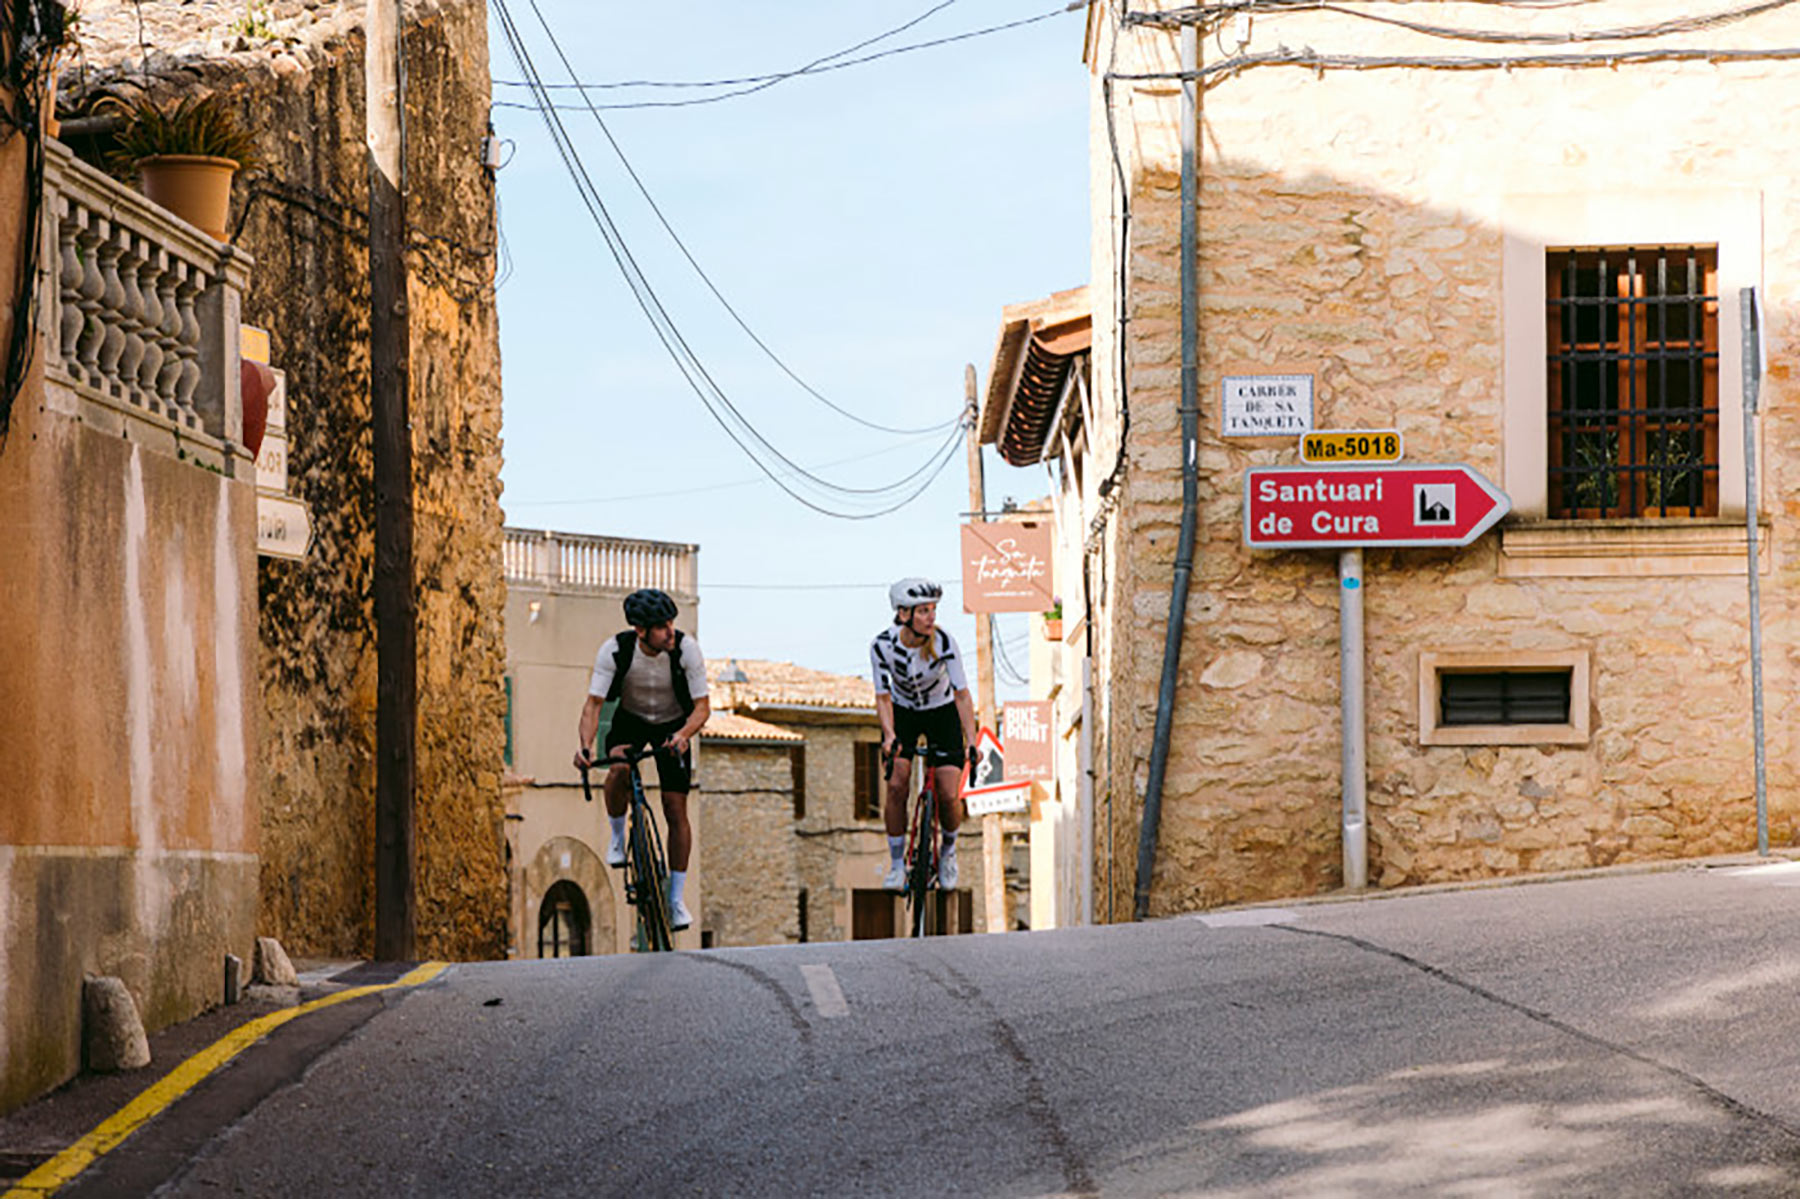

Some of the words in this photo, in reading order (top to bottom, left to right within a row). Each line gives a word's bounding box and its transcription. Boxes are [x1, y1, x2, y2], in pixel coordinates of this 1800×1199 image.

[1238, 385, 1297, 398] CARRER
[1245, 400, 1265, 413] DE
[1275, 401, 1295, 413] SA
[1231, 415, 1305, 430] TANQUETA
[1258, 477, 1383, 502] Santuari
[1258, 512, 1293, 535] de
[1311, 510, 1380, 534] Cura
[1006, 705, 1039, 721] BIKE
